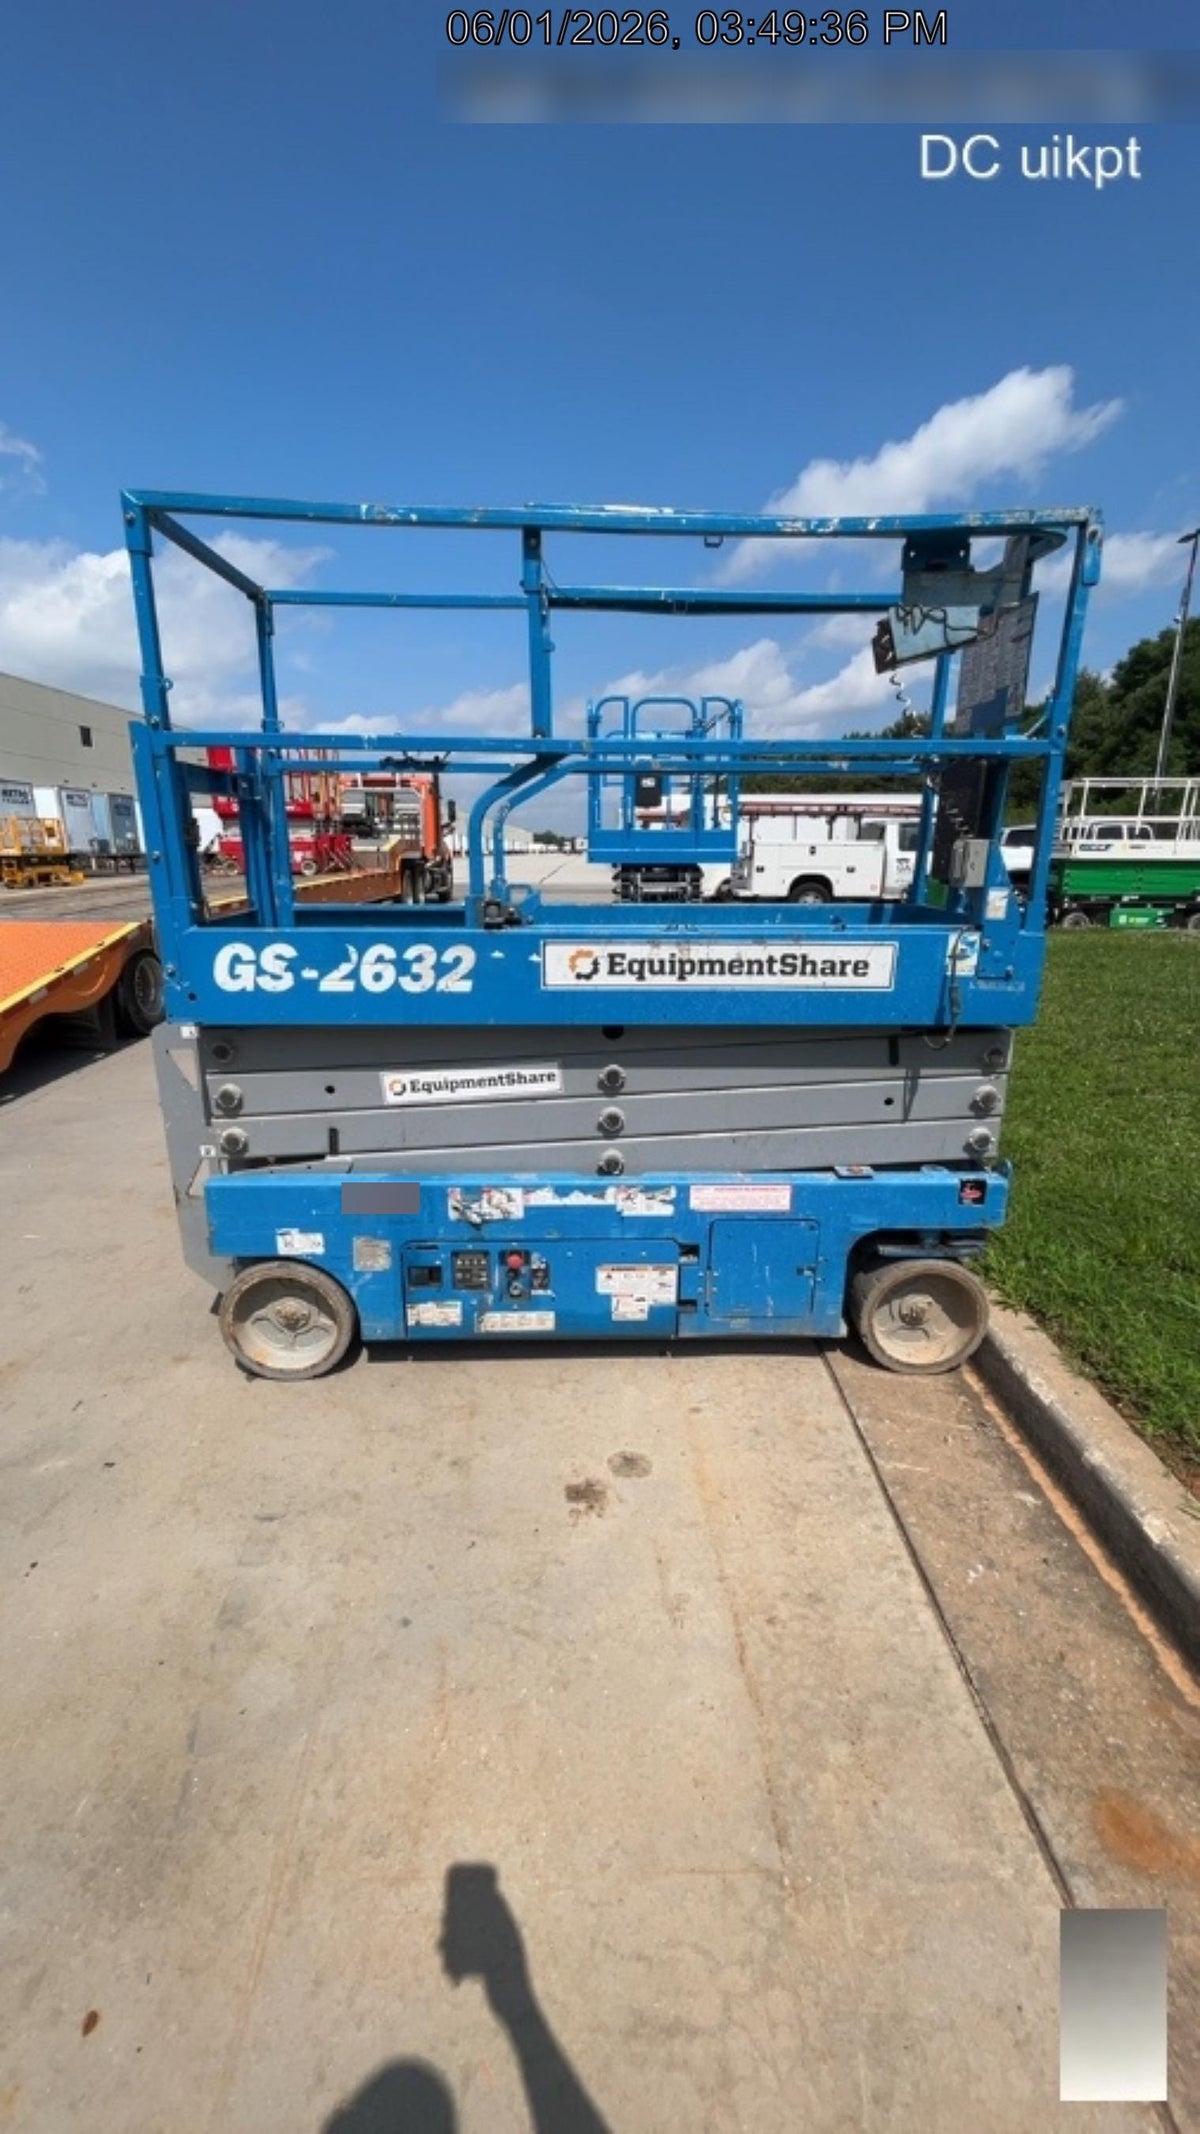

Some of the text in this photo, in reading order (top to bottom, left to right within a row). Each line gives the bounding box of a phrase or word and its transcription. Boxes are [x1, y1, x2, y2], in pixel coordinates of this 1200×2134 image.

[213, 943, 476, 993] GS-2632
[607, 953, 870, 980] EquipmentShare
[410, 1071, 557, 1093] EquipmentShare
